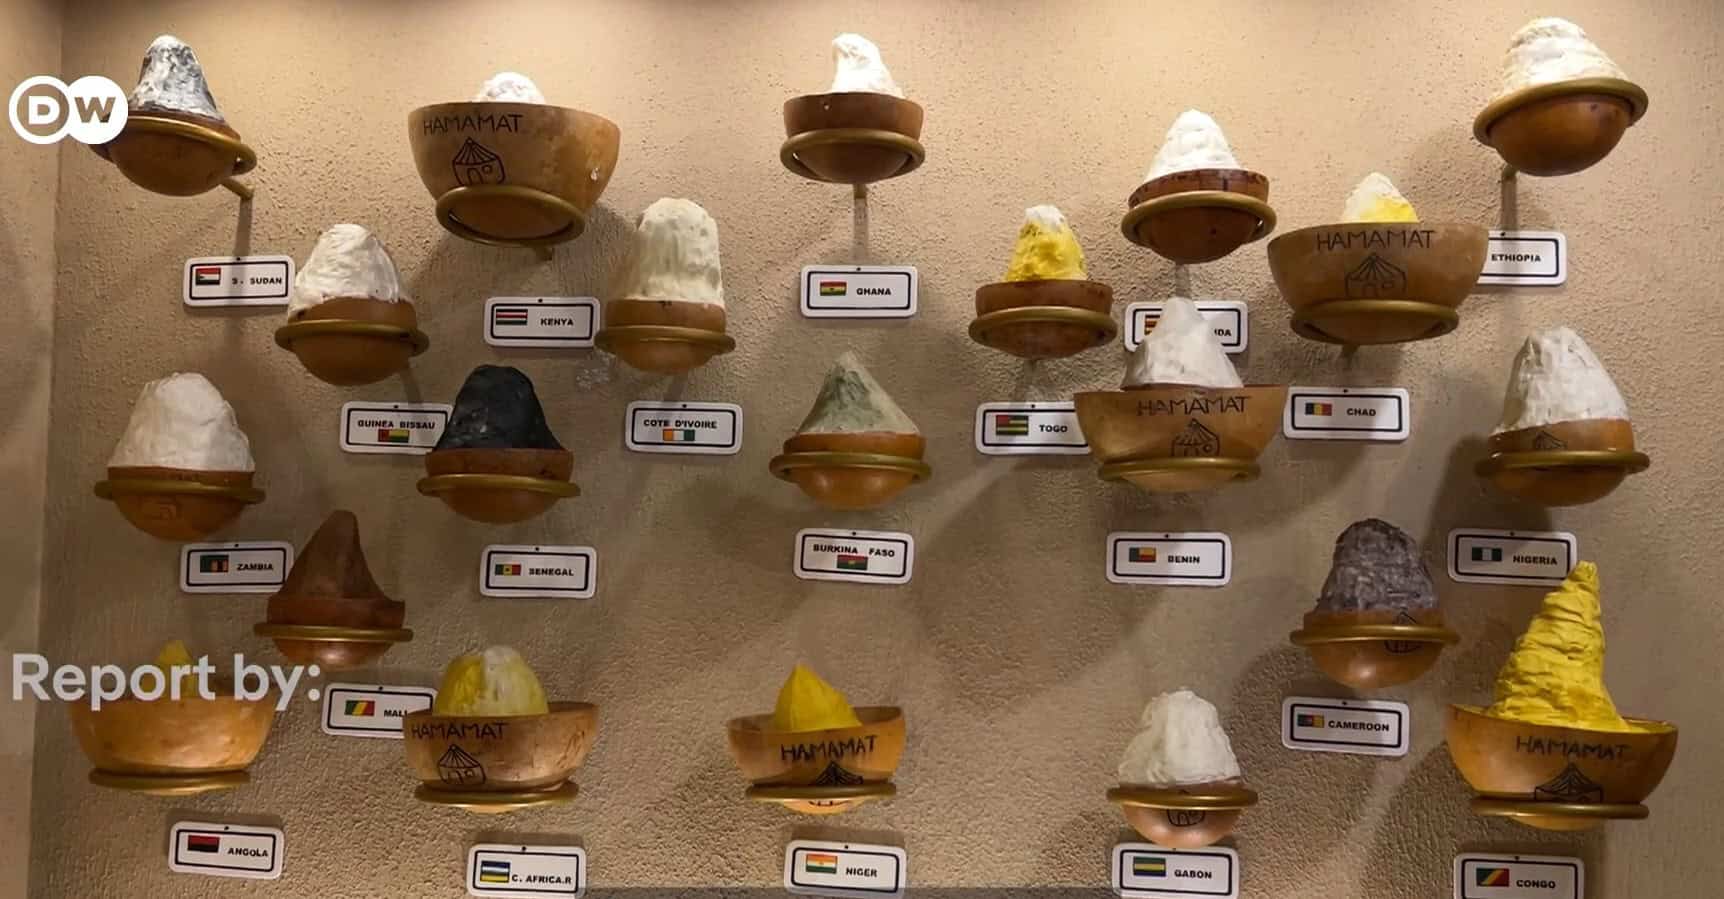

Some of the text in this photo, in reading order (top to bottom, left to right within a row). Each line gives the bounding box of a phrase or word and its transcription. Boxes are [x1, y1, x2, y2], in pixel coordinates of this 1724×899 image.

[423, 113, 524, 136] HAMAMAT
[1316, 229, 1436, 252] HAMAMAT
[1490, 253, 1542, 263] ETHIOPIA
[249, 276, 283, 285] SUDAN
[855, 287, 892, 296] GHANA
[540, 317, 574, 327] KENYA
[1136, 394, 1250, 418] HAMAMAT
[1345, 408, 1377, 417] CHAD
[357, 419, 436, 430] GUINEA BISSAU
[643, 418, 718, 429] COTE D'IVOIRE
[1038, 424, 1069, 433] TOGO
[812, 543, 896, 558] BURKINA FASO
[1167, 555, 1201, 565] BENIN
[1512, 555, 1558, 565] NIGERIA
[236, 562, 275, 572] ZAMBIA
[528, 567, 575, 577] SENEGAL
[1327, 720, 1390, 732] CAMEROON
[410, 721, 508, 743] HAMAMAT
[780, 734, 880, 763] HAMAMAT
[1516, 735, 1631, 761] HAMAMAT
[227, 847, 269, 858] ANGOLA
[845, 867, 878, 878] NIGER
[1173, 868, 1213, 880] GABON
[525, 874, 573, 885] AFRICA.R
[1516, 878, 1556, 889] CONGO
